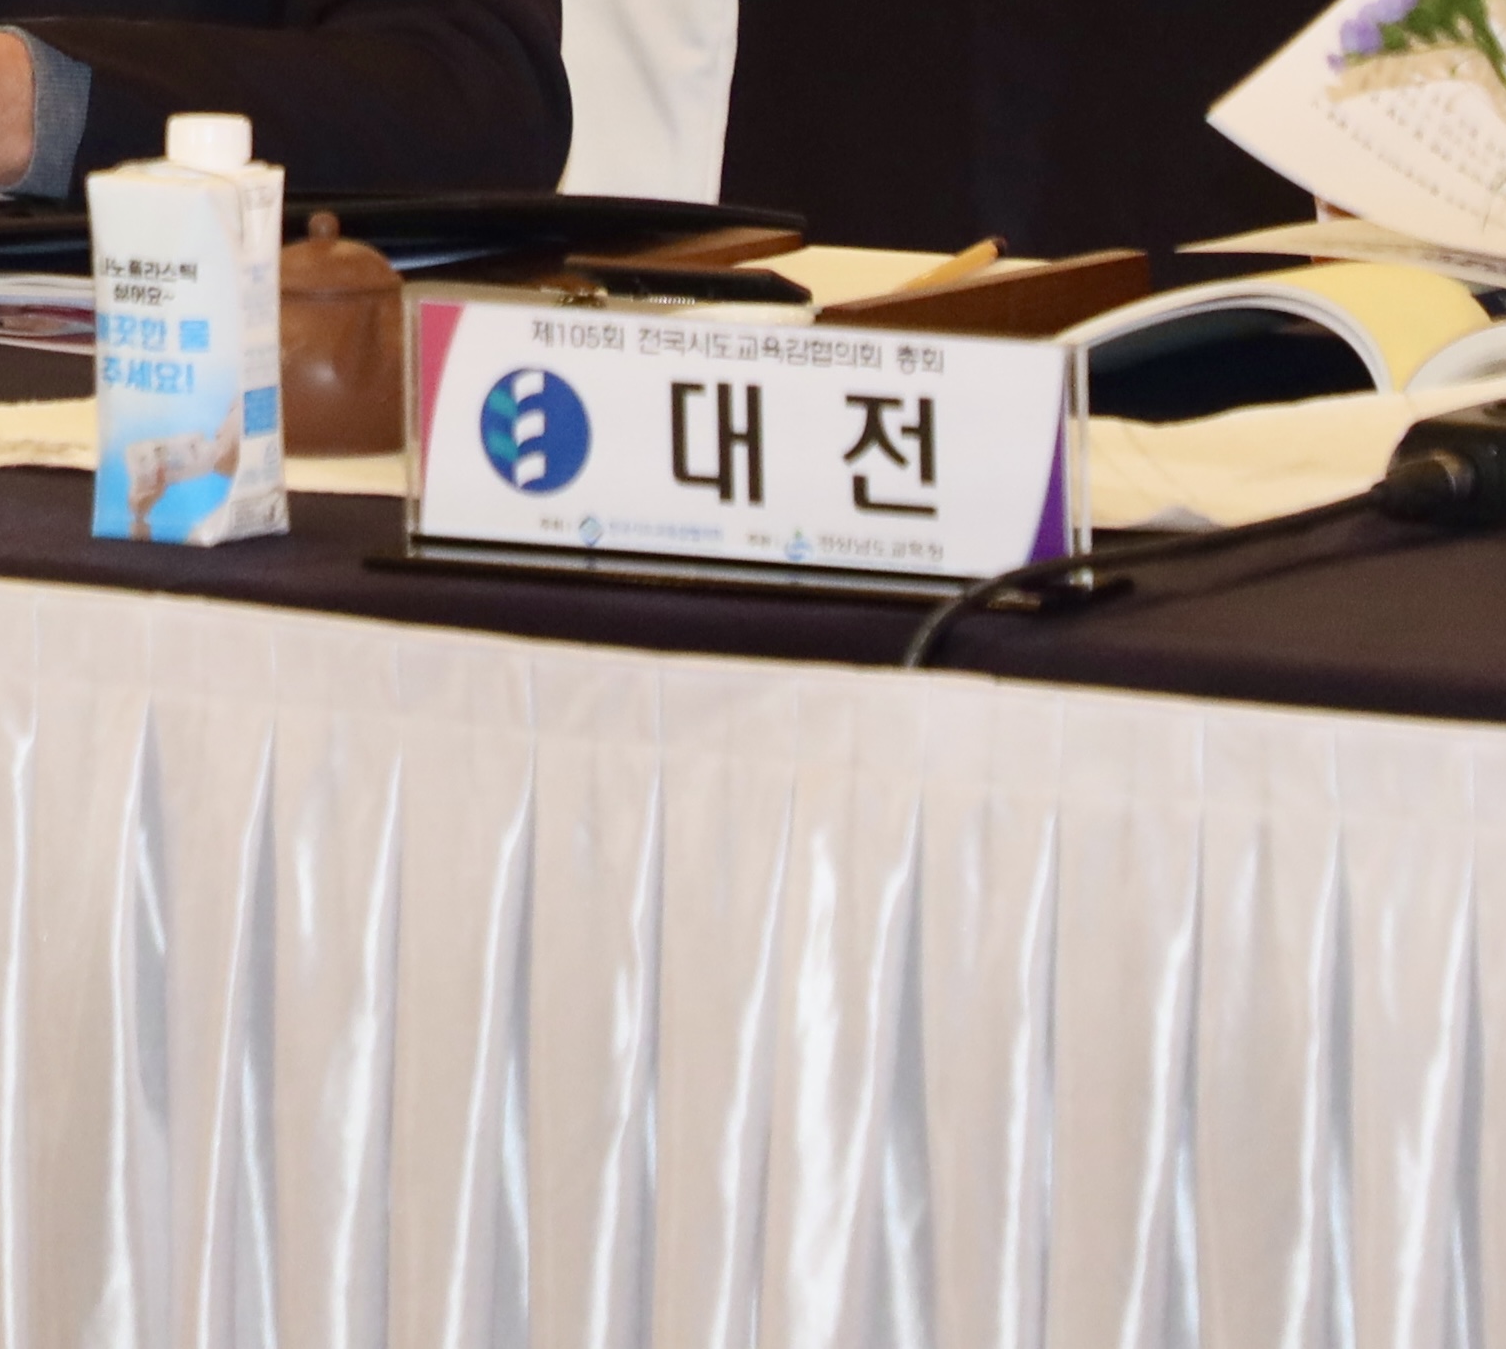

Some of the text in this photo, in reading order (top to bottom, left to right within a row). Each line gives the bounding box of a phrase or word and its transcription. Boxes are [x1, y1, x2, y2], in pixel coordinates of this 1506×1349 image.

[532, 320, 945, 375] 제105회 전국시도교육감협의회 총회
